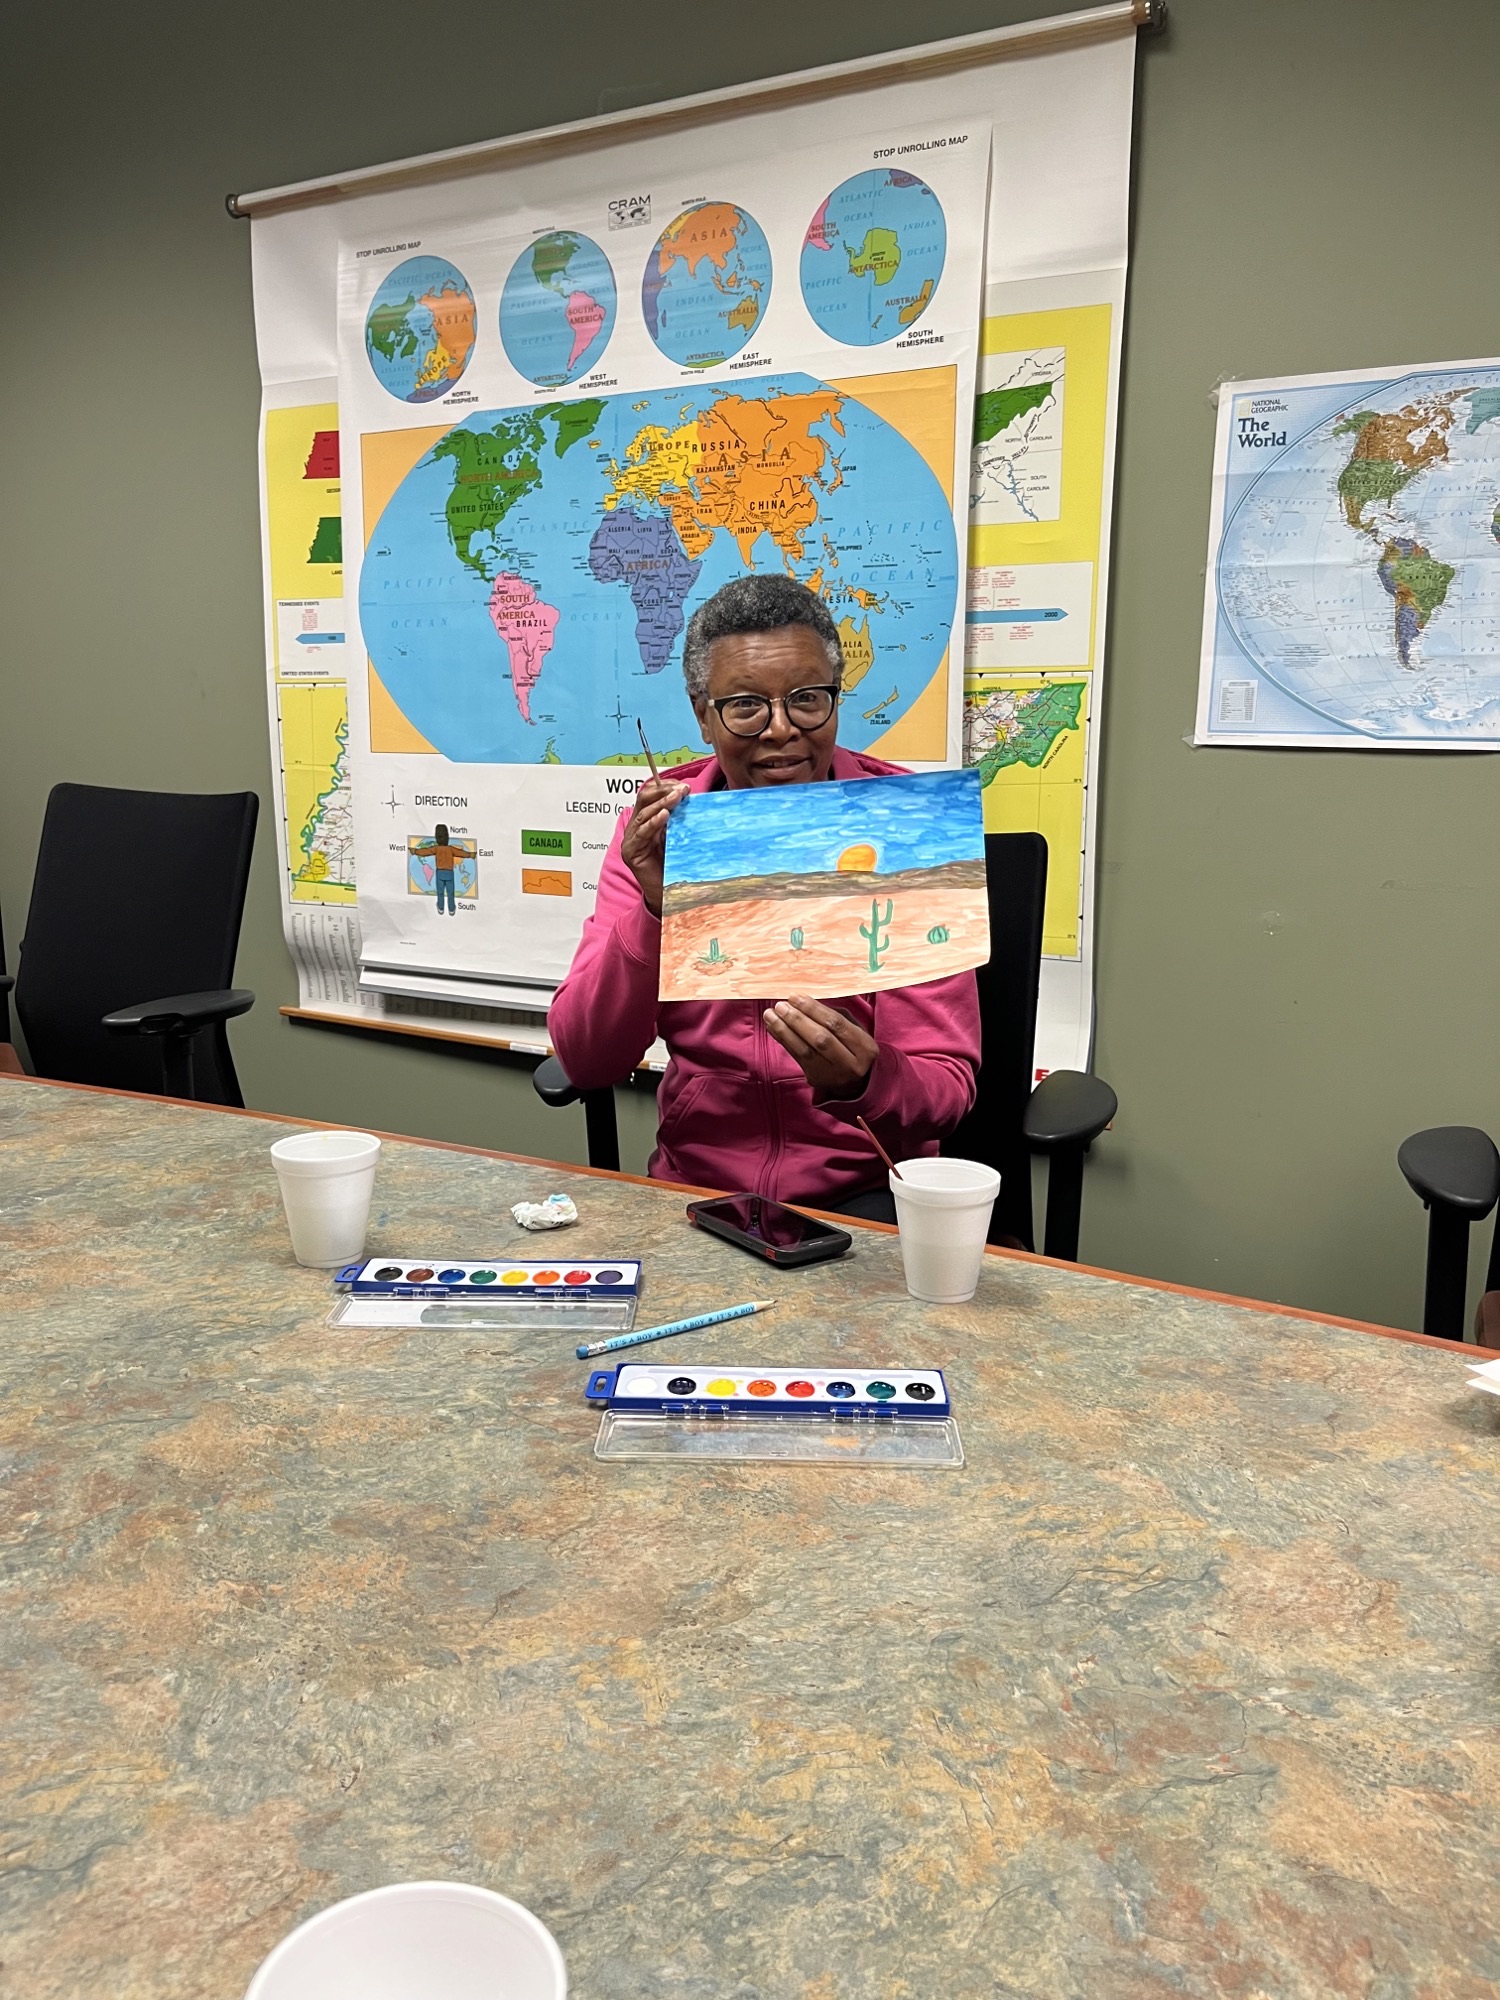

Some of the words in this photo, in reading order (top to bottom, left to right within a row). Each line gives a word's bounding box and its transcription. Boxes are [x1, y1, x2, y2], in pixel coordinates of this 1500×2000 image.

[873, 148, 895, 158] STOP
[897, 139, 946, 155] UNROLLING
[948, 135, 968, 146] MAP
[884, 176, 913, 188] AFRICA
[838, 188, 884, 204] ATLANTIC
[608, 194, 651, 211] CRAM
[844, 211, 874, 222] OCEAN
[811, 222, 836, 232] SOUTH
[902, 218, 937, 232] INDIAN
[690, 228, 728, 243] ASIA
[807, 229, 840, 240] AMERICA
[356, 250, 372, 258] STOP
[373, 242, 406, 256] UNROLLING
[408, 240, 422, 250] MAP
[907, 244, 938, 257] OCEAN
[848, 259, 900, 274] ANTARCTICA
[805, 277, 842, 290] PACIFIC
[676, 294, 714, 306] INDIAN
[885, 294, 928, 307] AUSTRALIA
[568, 306, 594, 316] SOUTH
[718, 306, 758, 318] AUSTRALIA
[816, 302, 848, 314] OCEAN
[436, 313, 469, 326] ASIA
[569, 314, 603, 326] AMERICA
[675, 328, 710, 338] OCEAN
[908, 329, 934, 338] SOUTH
[896, 336, 944, 348] HEMISPHERE
[686, 350, 724, 361] ANTARCTICA
[742, 352, 760, 360] EAST
[729, 358, 772, 370] HEMISPHERE
[418, 356, 448, 386] EUROPE
[578, 378, 618, 390] HEMISPHERE
[590, 374, 607, 382] WEST
[452, 390, 471, 398] NORTH
[442, 396, 479, 405] HEMISPHERE
[1252, 399, 1281, 407] NATIONAL
[1251, 404, 1288, 414] GEOGRAPHIC
[1238, 418, 1270, 432] The
[1237, 431, 1287, 448] World
[641, 440, 690, 453] EUROPE
[692, 440, 740, 453] RUSSIA
[477, 454, 521, 466] CANADA
[718, 447, 790, 465] ASIA
[696, 464, 736, 473] KAZAKHSTAN
[451, 505, 476, 514] UNITED
[479, 502, 504, 511] STATES
[749, 500, 785, 510] CHINA
[510, 520, 590, 534] ATLANTIC
[738, 526, 757, 534] INDIA
[838, 519, 942, 537] PACIFIC
[627, 560, 669, 571] AFRICA
[851, 568, 934, 582] OCEAN
[384, 576, 455, 589] PACIFIC
[500, 594, 530, 603] SOUTH
[496, 610, 535, 620] AMERICA
[391, 618, 448, 629] OCEAN
[516, 619, 547, 628] BRAZIL
[1042, 752, 1055, 770] NORTH
[1052, 735, 1069, 757] CAROLINA
[415, 795, 468, 807] DIRECTION
[566, 801, 611, 813] LEGEND
[450, 826, 468, 834] North
[529, 837, 564, 849] CANADA
[479, 849, 494, 857] East
[458, 902, 476, 911] South
[610, 1339, 626, 1348] IT'S
[637, 1332, 652, 1342] BOY
[664, 1326, 680, 1334] IT'S
[689, 1319, 705, 1328] BOY
[716, 1312, 732, 1320] IT'S
[741, 1306, 756, 1314] BOY
